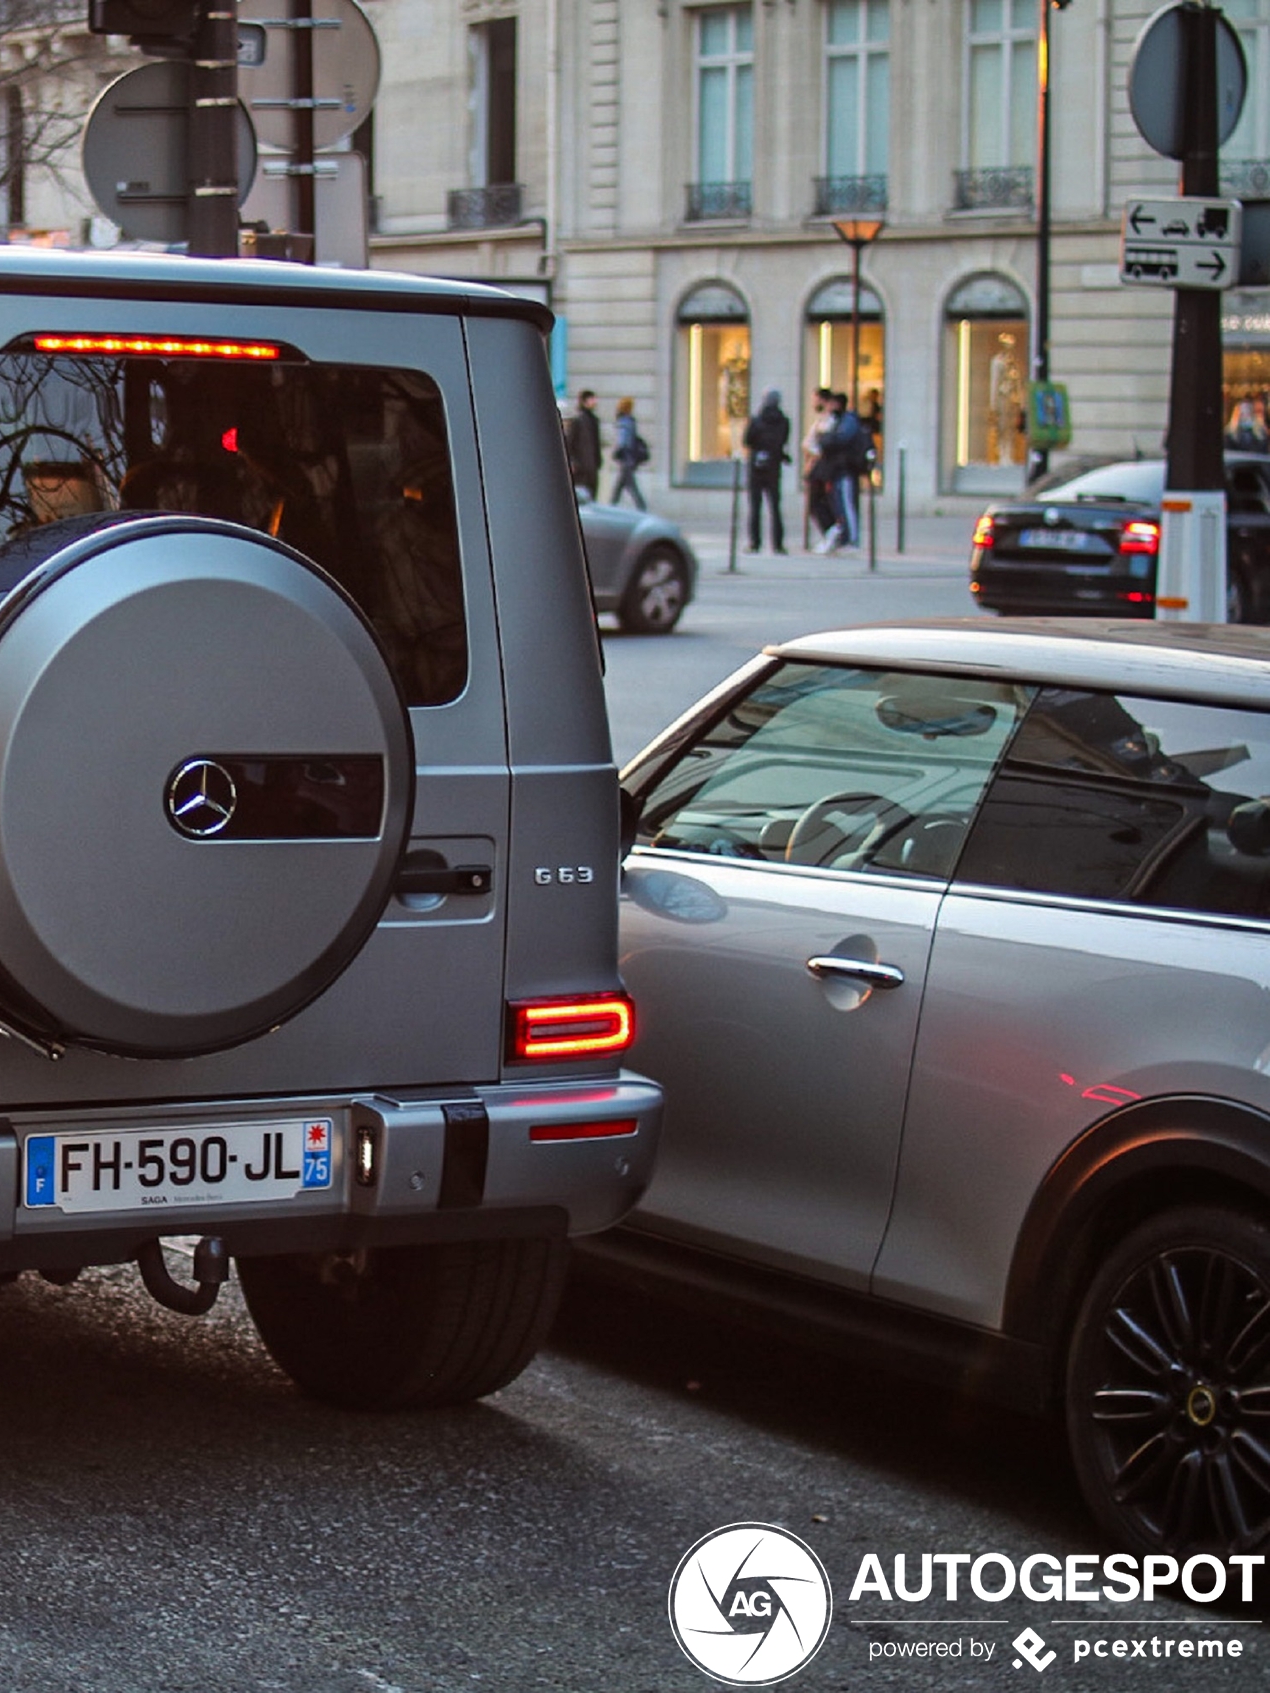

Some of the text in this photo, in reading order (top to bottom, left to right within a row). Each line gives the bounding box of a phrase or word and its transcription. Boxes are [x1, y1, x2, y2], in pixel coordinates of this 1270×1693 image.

[535, 866, 593, 885] G 63
[60, 1131, 301, 1193] FH-590-JL
[305, 1157, 328, 1181] 75
[36, 1178, 46, 1193] F
[141, 1195, 168, 1205] SAGA
